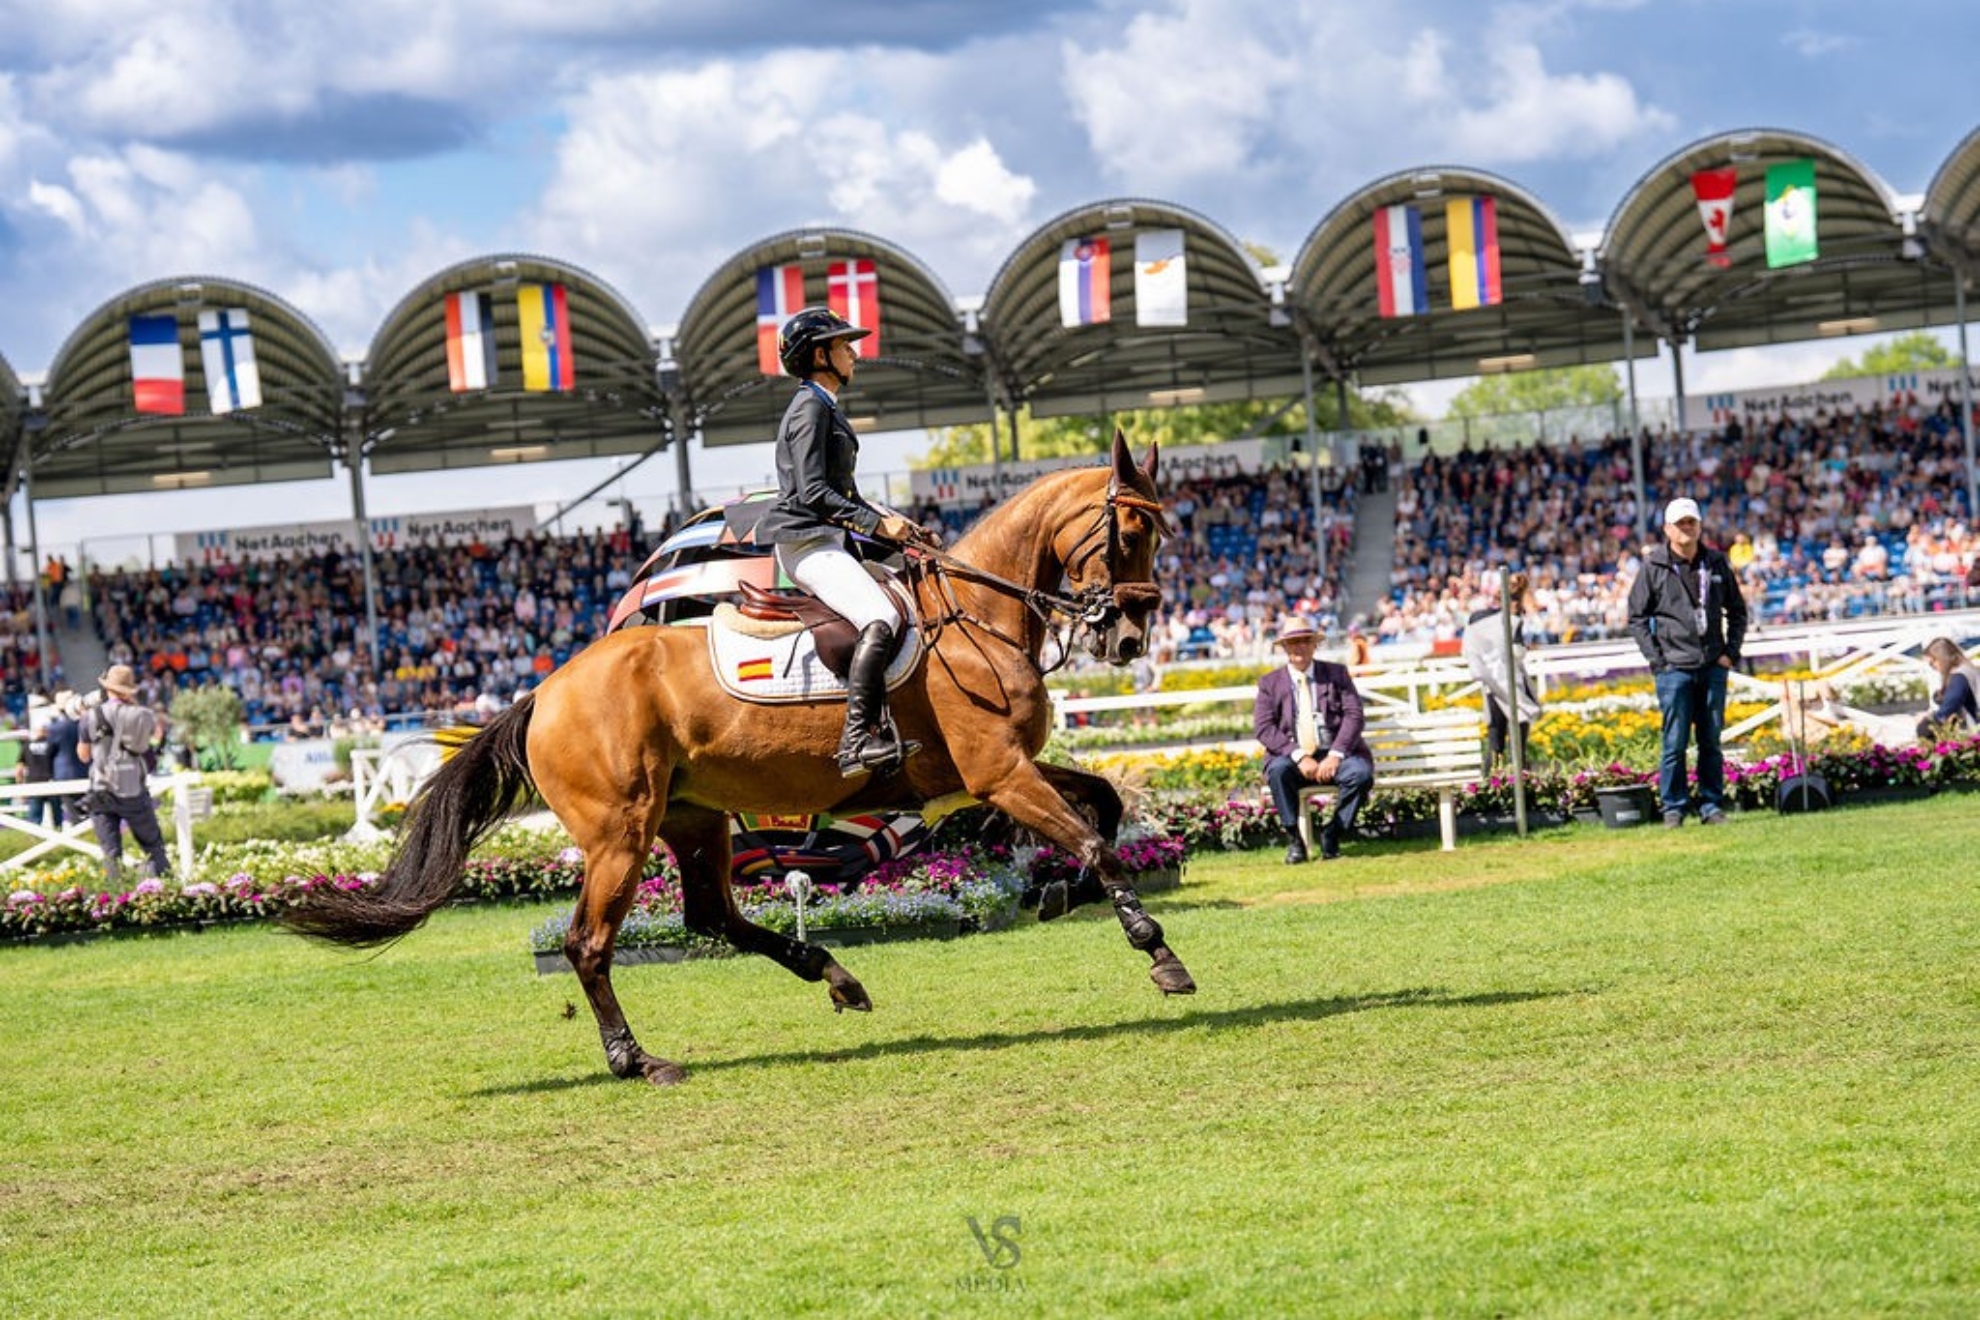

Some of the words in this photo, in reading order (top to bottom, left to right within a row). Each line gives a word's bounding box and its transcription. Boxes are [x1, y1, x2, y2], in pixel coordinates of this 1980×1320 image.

[1743, 391, 1853, 411] NetAachen
[407, 518, 512, 537] NetAachen
[235, 530, 343, 551] NetAachen
